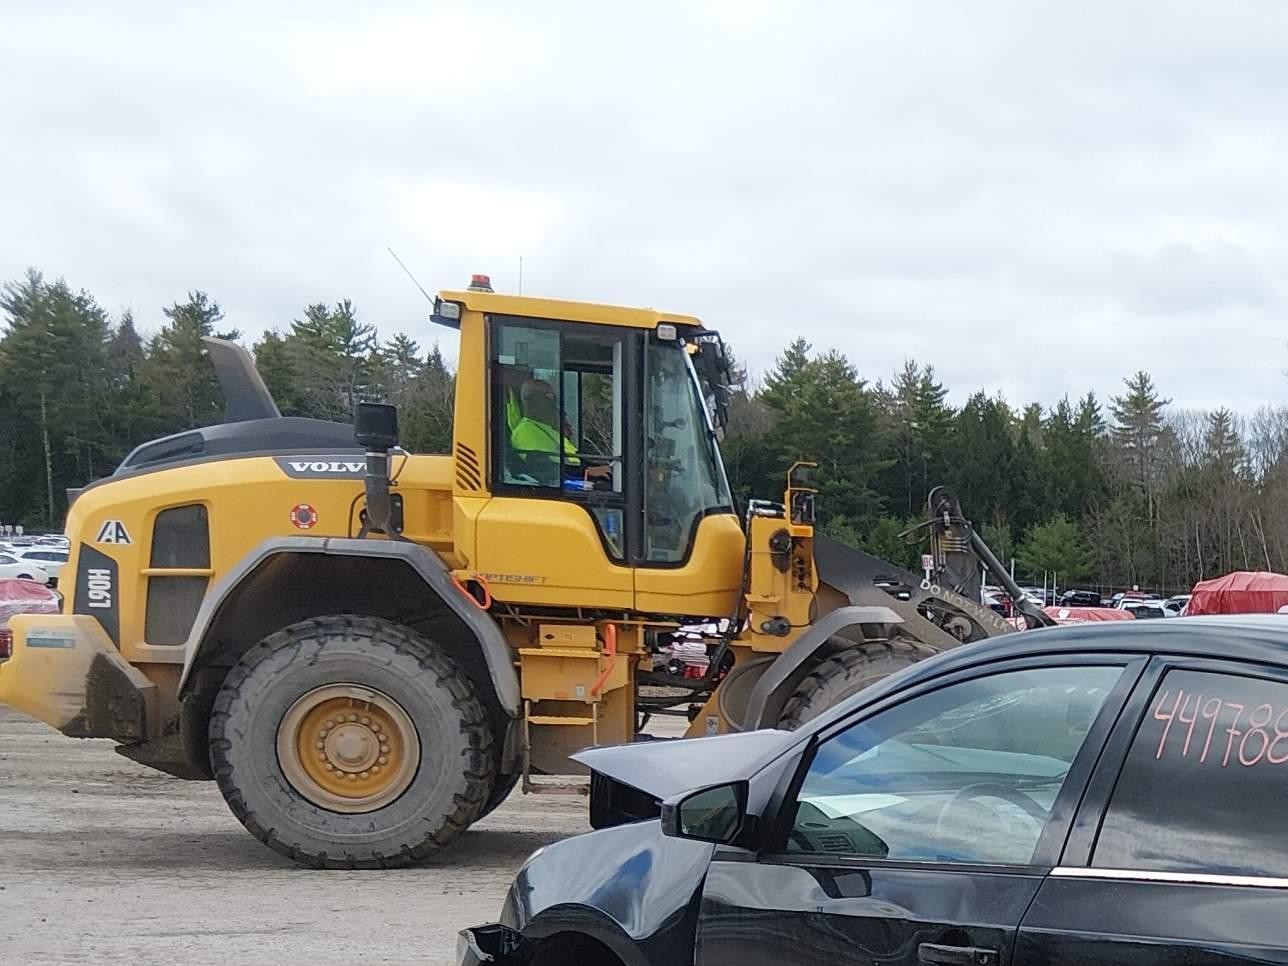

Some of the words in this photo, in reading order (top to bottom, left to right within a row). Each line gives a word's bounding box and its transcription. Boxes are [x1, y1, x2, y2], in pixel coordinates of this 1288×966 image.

[288, 461, 367, 472] VOLV
[87, 568, 112, 609] L90H
[920, 578, 941, 596] DO
[943, 590, 972, 609] NOT
[975, 605, 1009, 633] WLK
